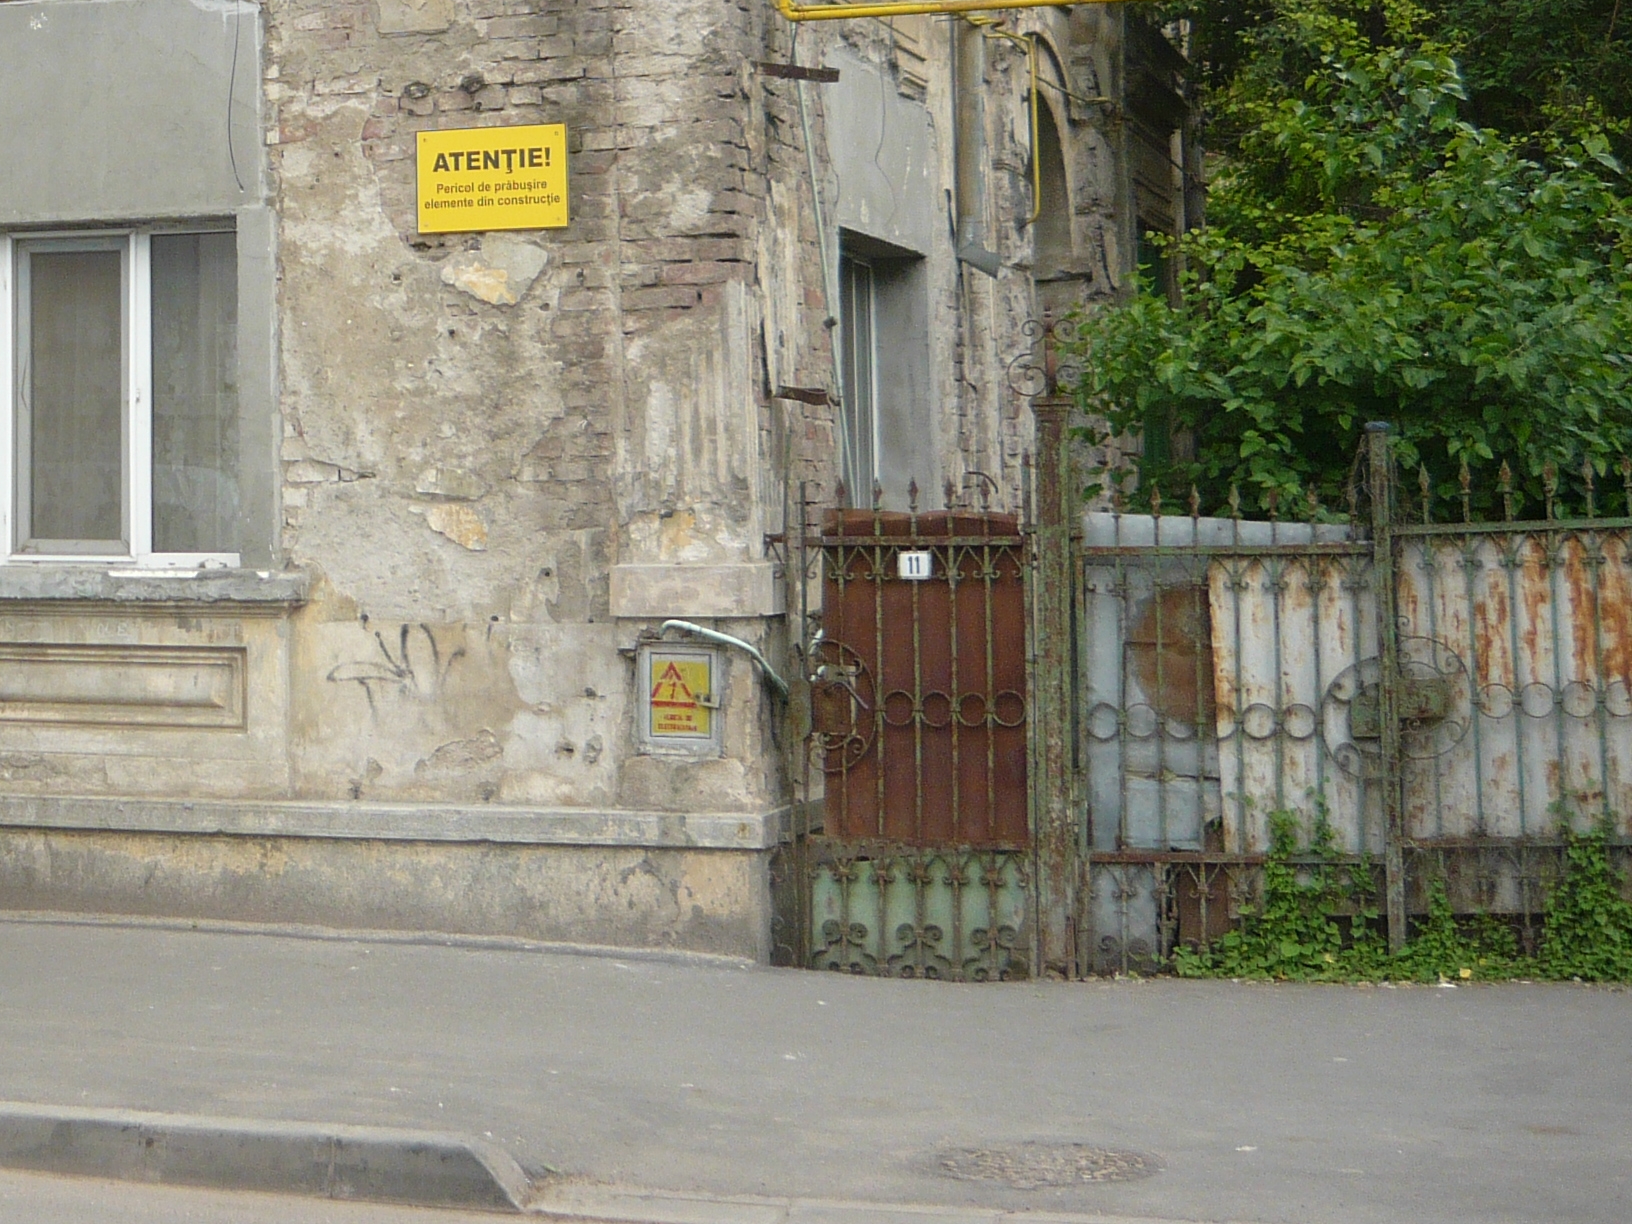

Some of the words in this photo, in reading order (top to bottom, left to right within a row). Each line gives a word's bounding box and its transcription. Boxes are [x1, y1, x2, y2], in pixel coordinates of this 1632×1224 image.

[436, 182, 474, 194] Pericol
[477, 181, 491, 192] de
[424, 198, 474, 209] elemente
[477, 195, 494, 207] din
[908, 556, 919, 574] 11
